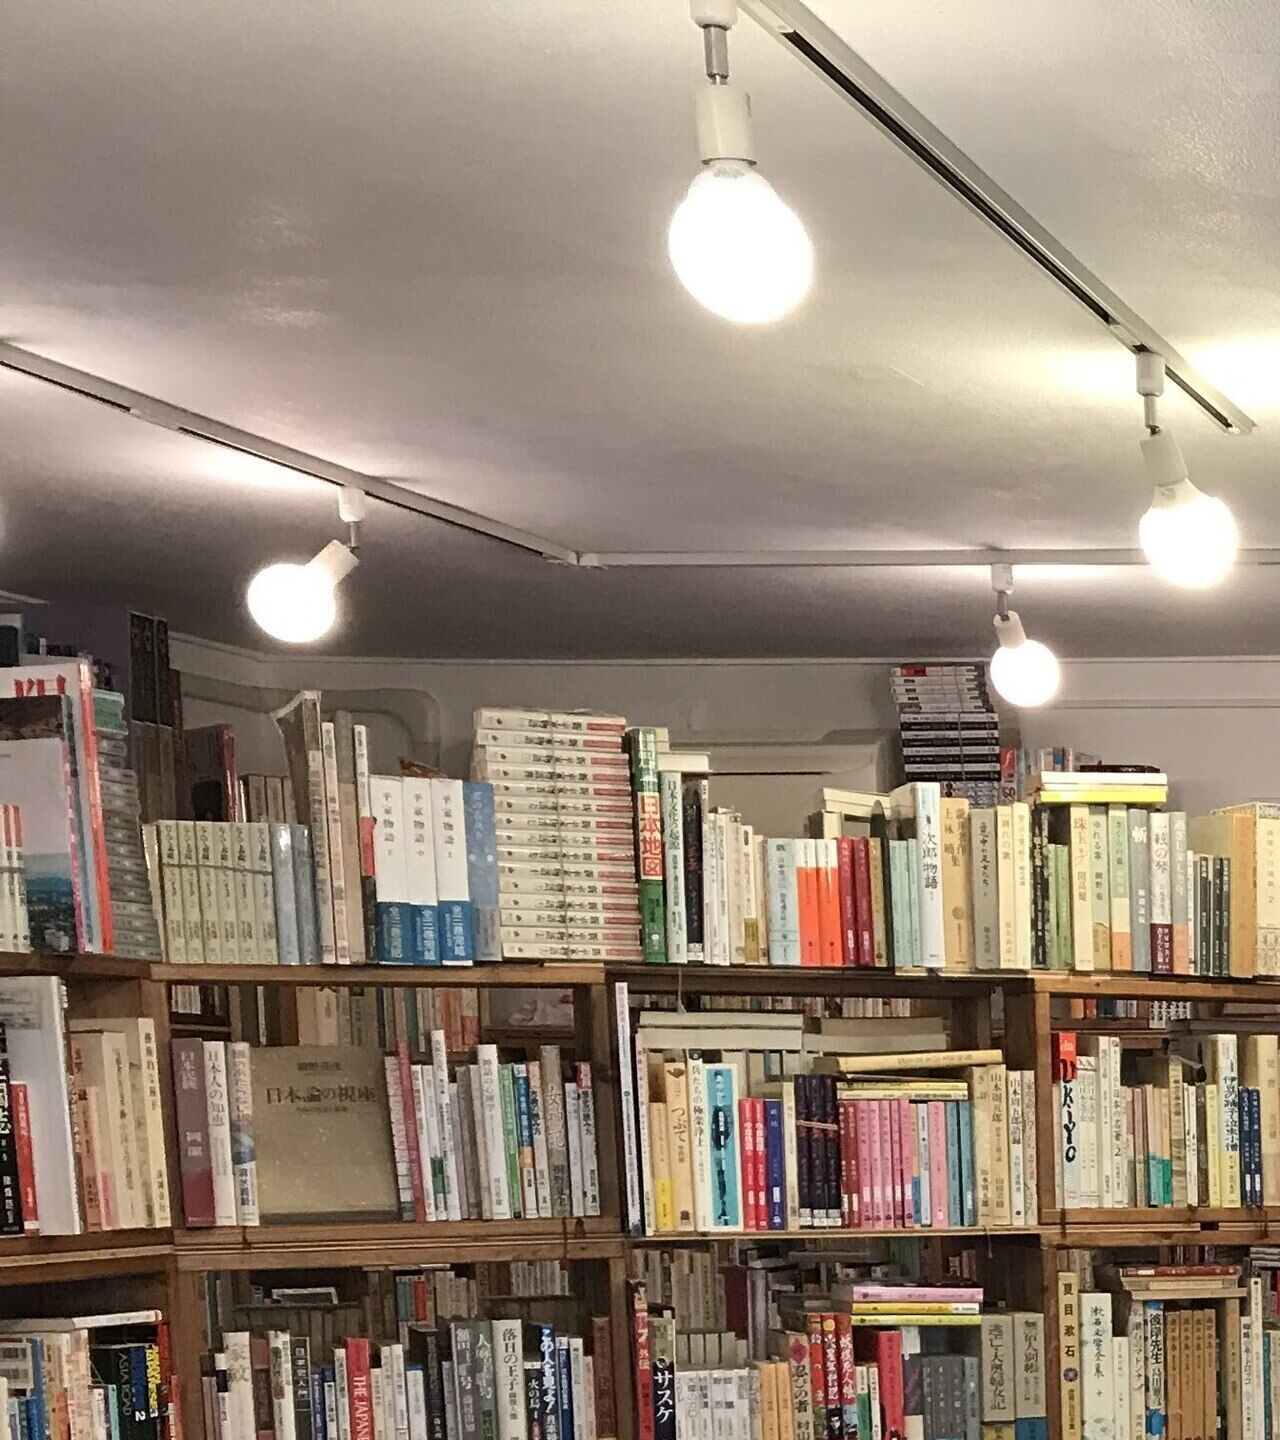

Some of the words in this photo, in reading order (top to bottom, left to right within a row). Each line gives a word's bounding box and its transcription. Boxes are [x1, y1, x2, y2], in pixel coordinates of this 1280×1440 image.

[1062, 1281, 1075, 1359] 夏目漱石
[352, 1376, 366, 1400] THE
[652, 1371, 674, 1423] サスケ
